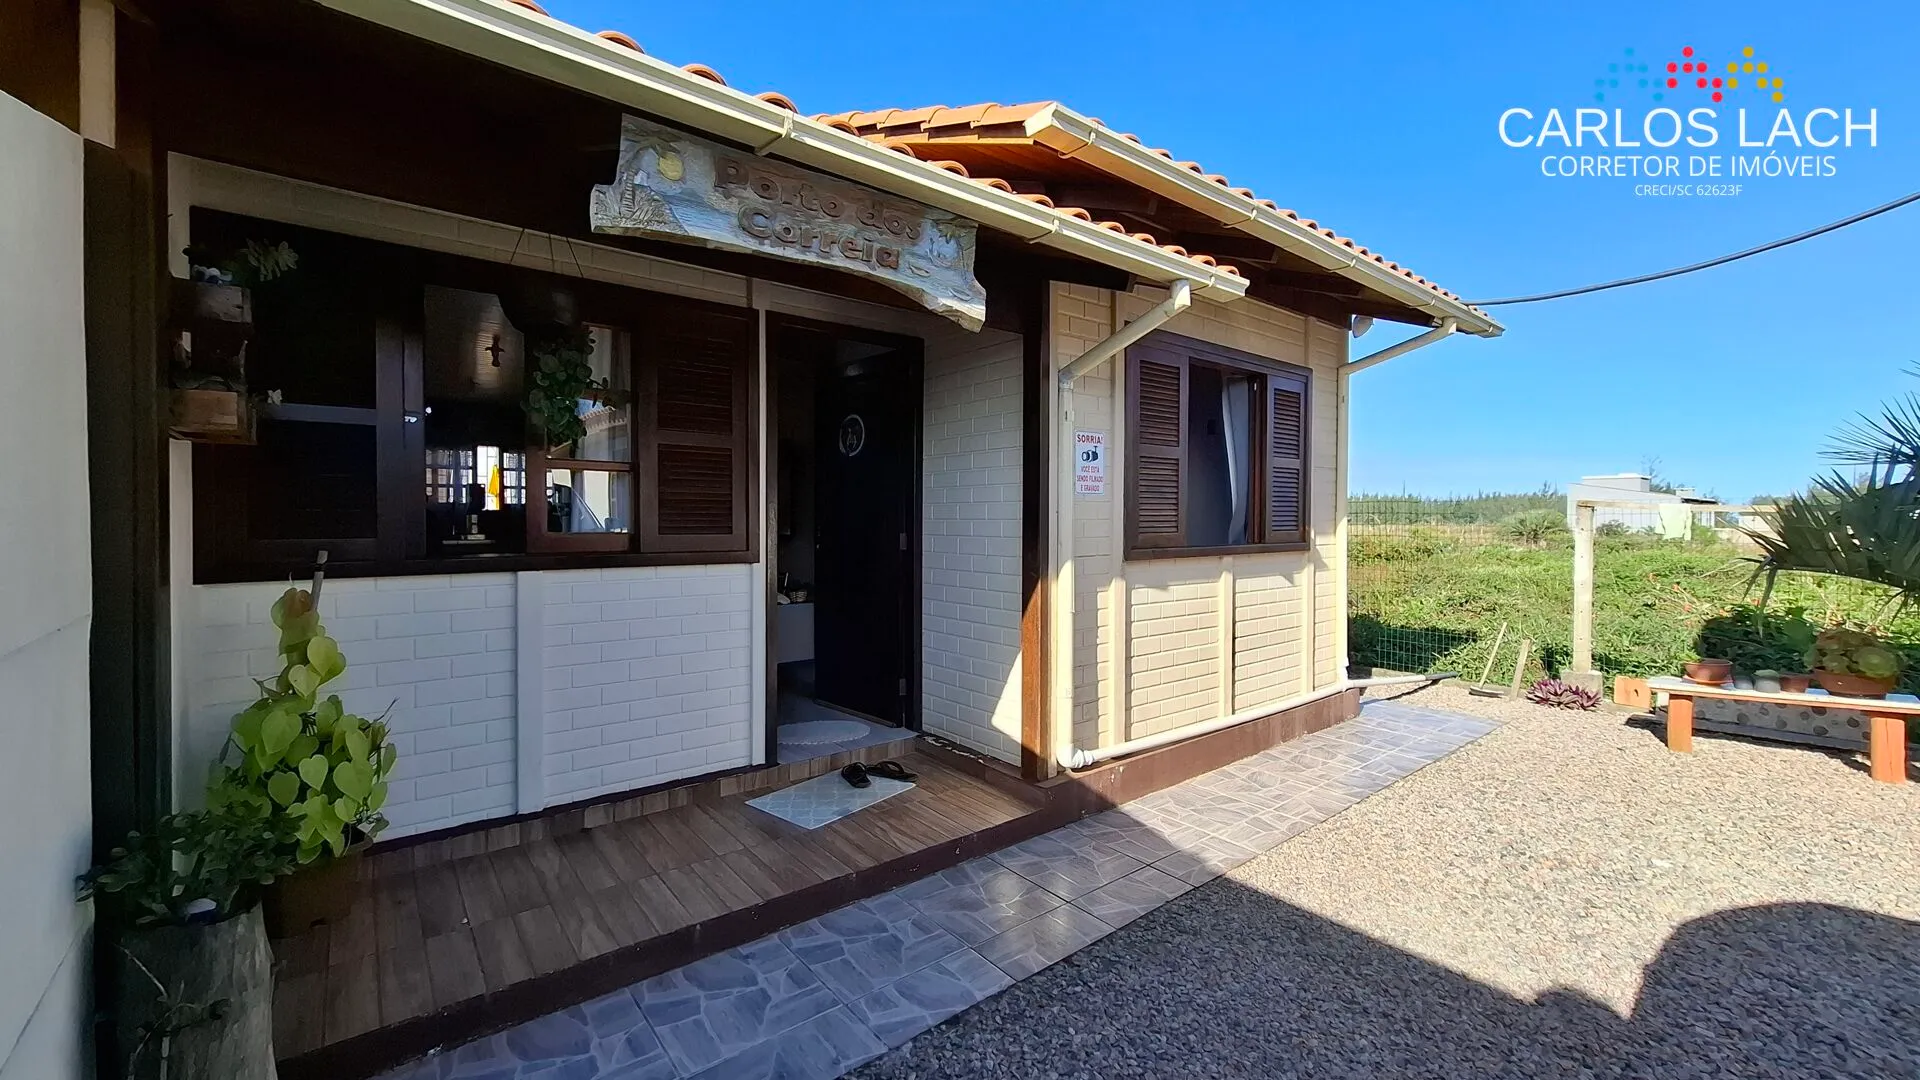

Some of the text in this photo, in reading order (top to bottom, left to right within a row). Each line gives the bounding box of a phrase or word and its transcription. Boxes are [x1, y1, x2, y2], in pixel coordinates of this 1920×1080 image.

[714, 155, 922, 241] Porto dos
[738, 203, 900, 269] Correia
